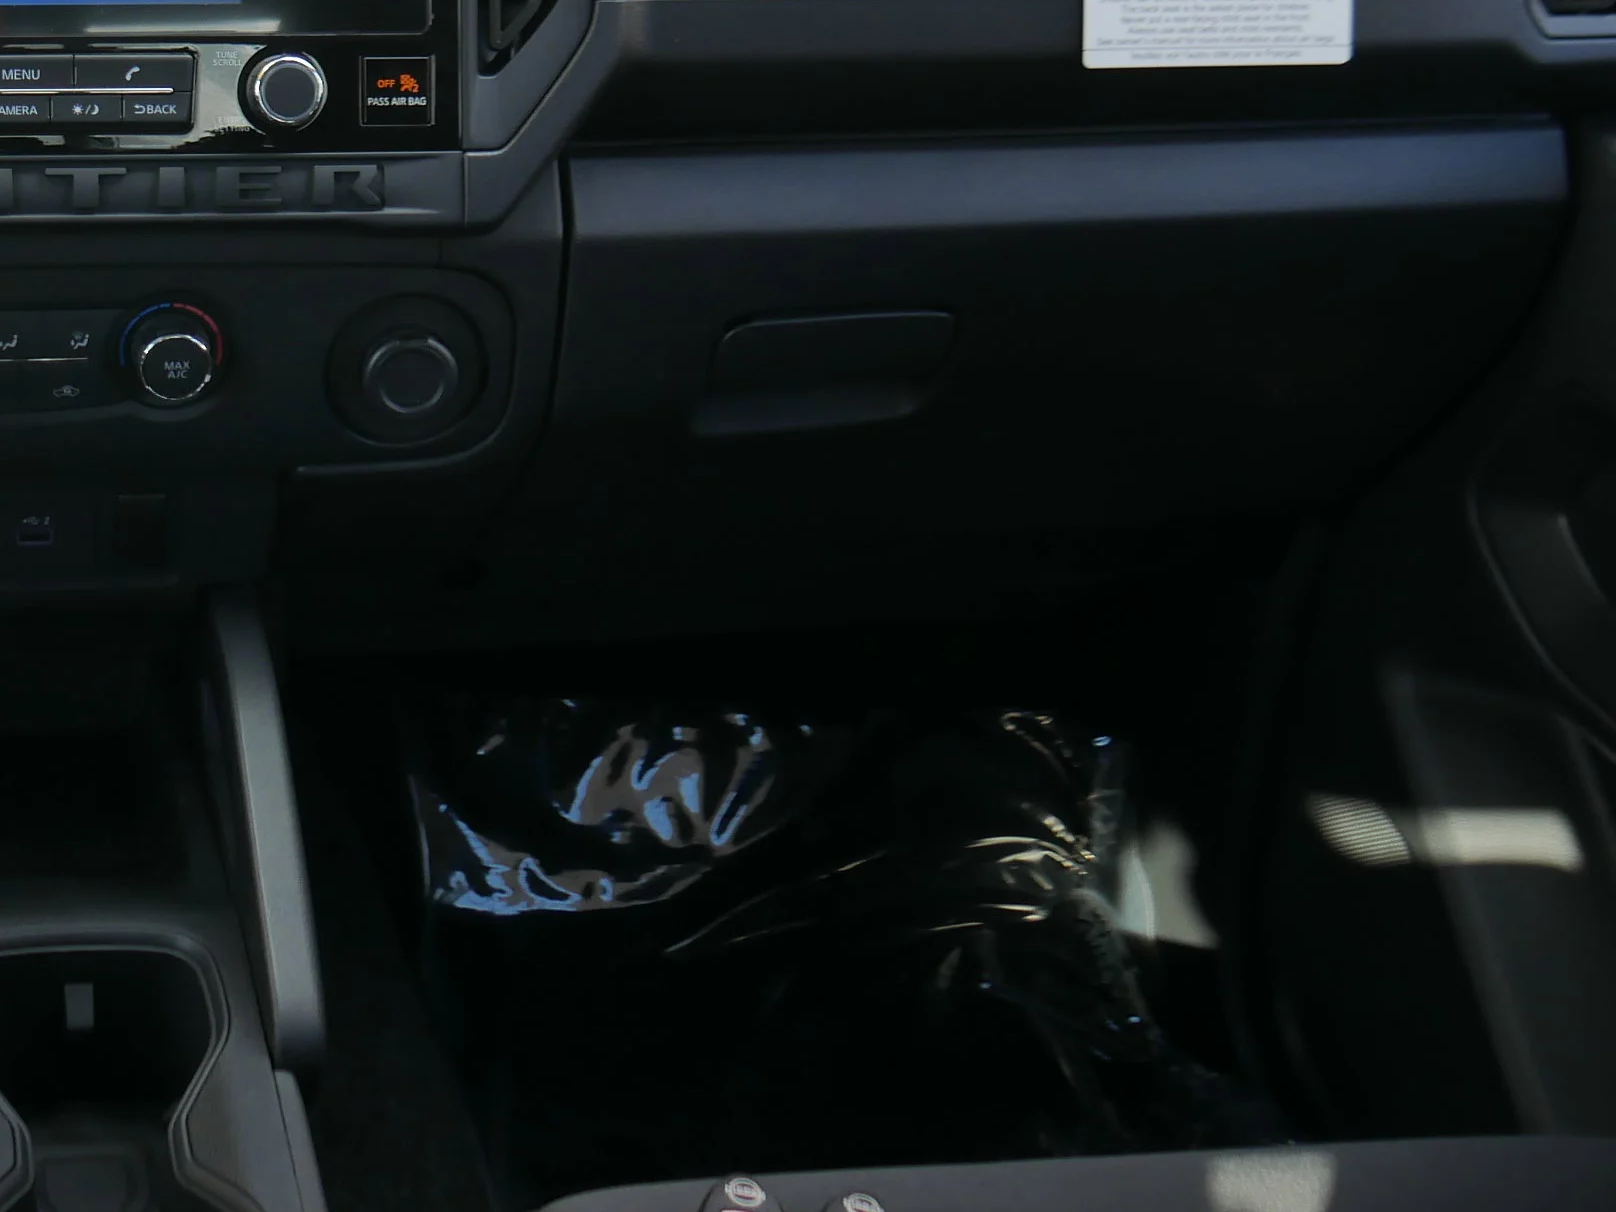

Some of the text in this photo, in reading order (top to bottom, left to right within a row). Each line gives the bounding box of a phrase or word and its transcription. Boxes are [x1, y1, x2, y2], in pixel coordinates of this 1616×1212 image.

[216, 51, 238, 59] TUNE
[212, 58, 242, 67] SCROLL
[2, 69, 41, 81] MENU
[376, 79, 396, 88] OFF
[367, 96, 426, 106] PASS AIR BAG
[146, 103, 177, 115] BACK
[164, 360, 191, 369] MAX
[167, 370, 189, 380] A/C
